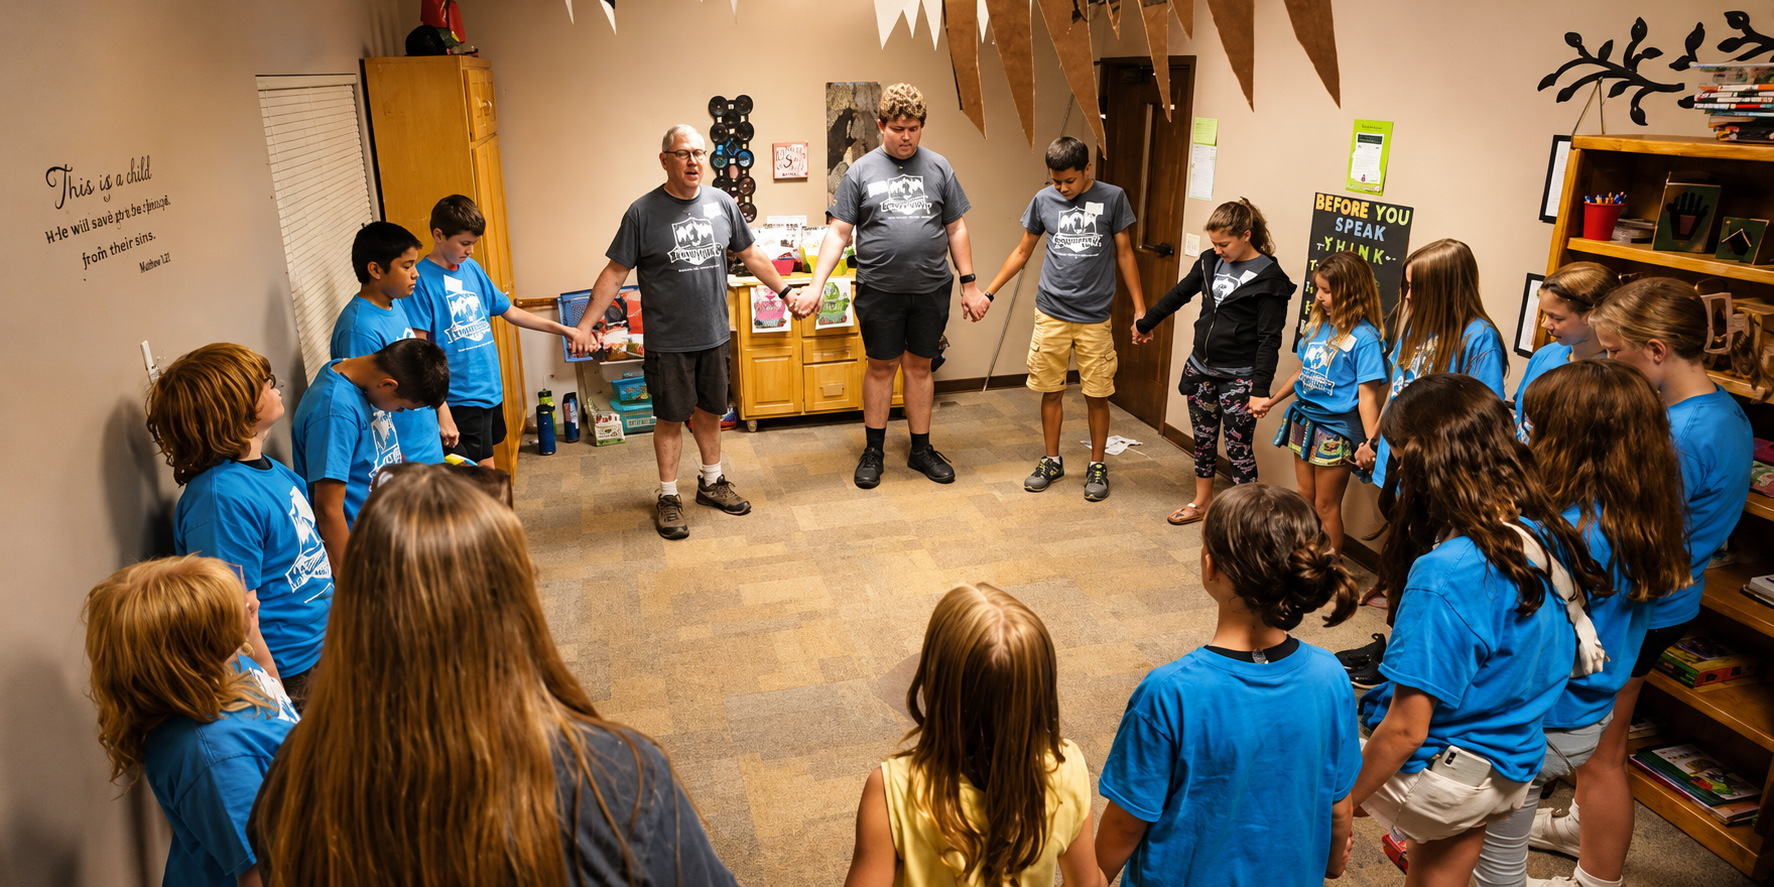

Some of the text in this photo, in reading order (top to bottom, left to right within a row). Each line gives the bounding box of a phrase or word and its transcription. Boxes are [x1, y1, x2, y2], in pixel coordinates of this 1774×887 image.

[45, 155, 152, 209] This is a child
[1315, 193, 1410, 226] BEFORE YOU
[1335, 217, 1387, 242] SPEAK
[82, 231, 156, 270] from their sins.
